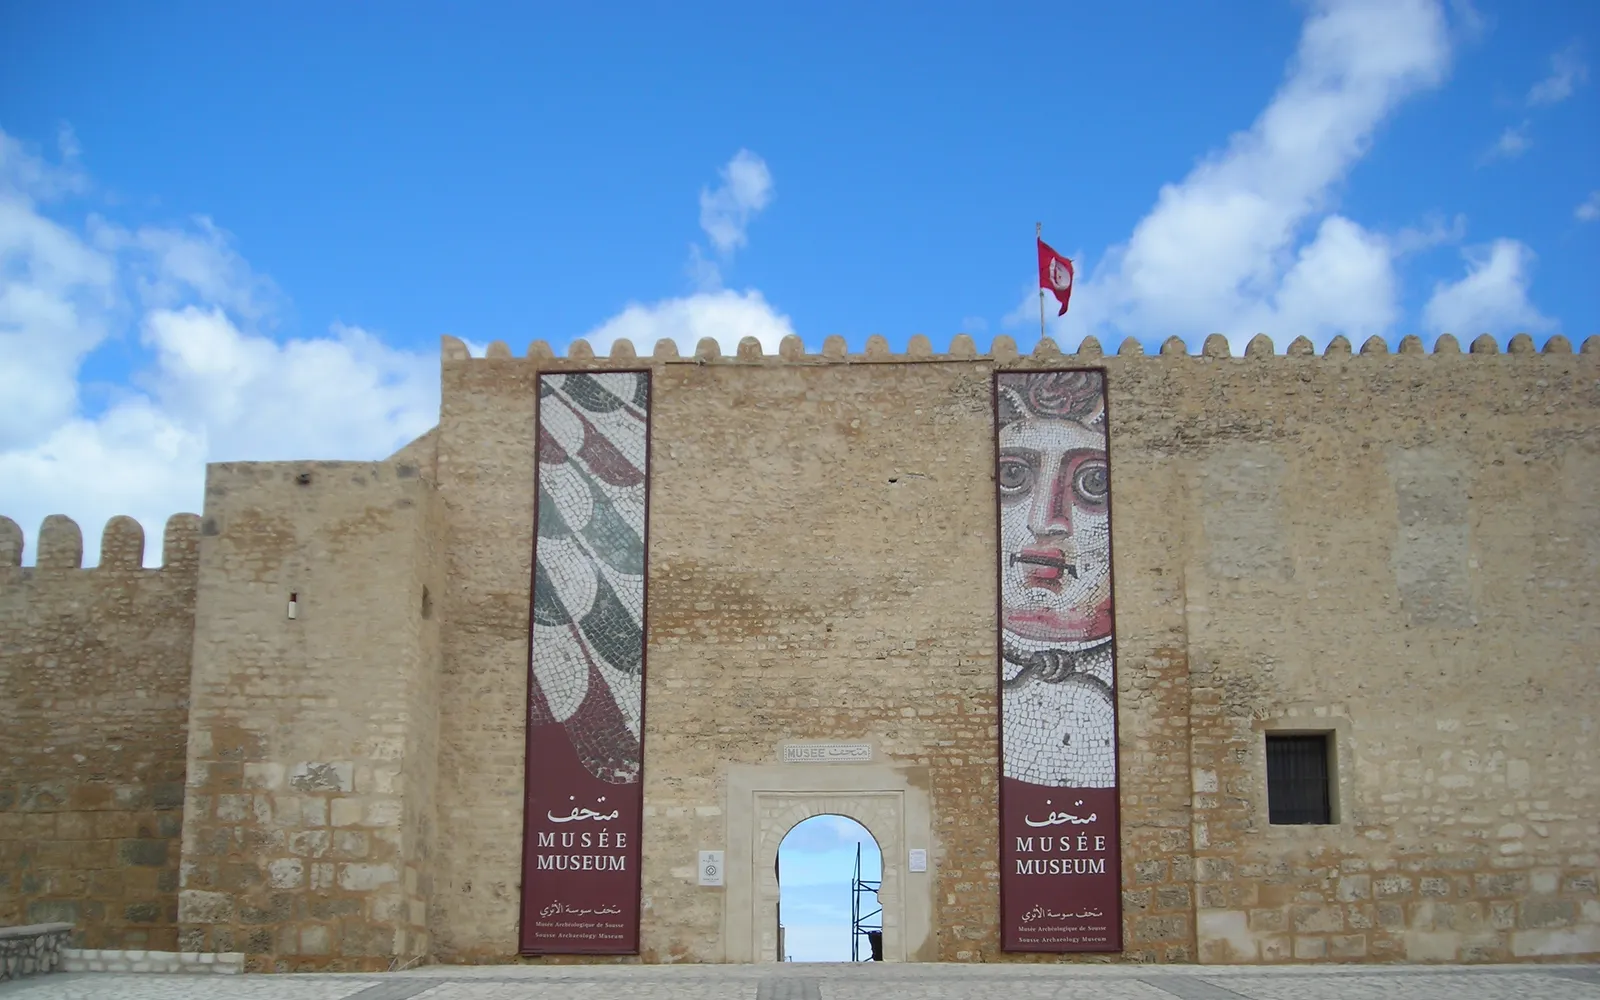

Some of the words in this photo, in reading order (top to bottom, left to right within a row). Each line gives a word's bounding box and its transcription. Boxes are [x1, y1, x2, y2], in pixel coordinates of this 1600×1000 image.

[787, 748, 825, 758] MUSEE
[828, 748, 868, 757] متحف
[547, 795, 619, 823] متحف
[1024, 799, 1097, 828] متحف
[537, 828, 627, 848] MUSÉE
[1016, 831, 1106, 852] MUSÉE
[536, 855, 626, 871] MUSEUM
[1016, 858, 1106, 875] MUSEUM
[539, 899, 564, 919] الأثري
[565, 904, 592, 917] سوسة
[593, 904, 622, 915] متحف
[1021, 904, 1046, 923] الأثري
[1047, 908, 1074, 921] سوسة
[1075, 907, 1103, 918] متحف
